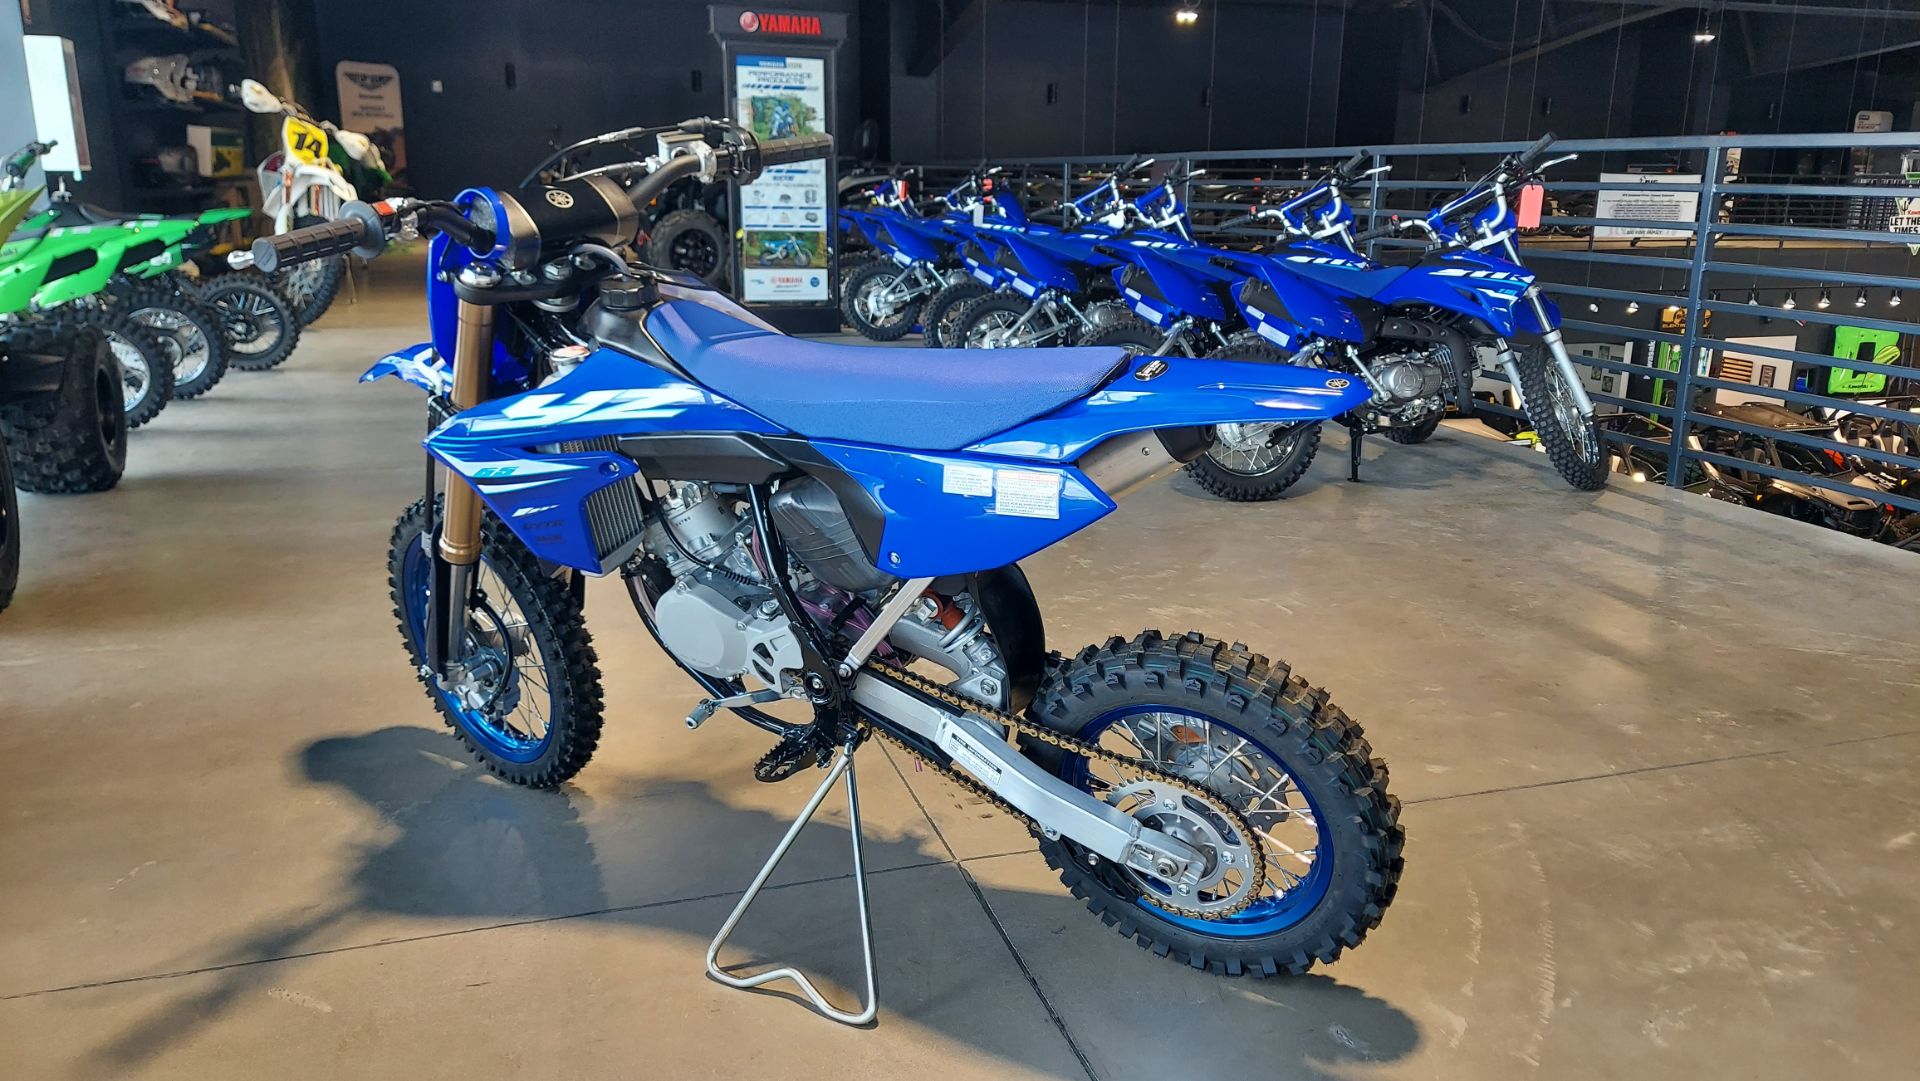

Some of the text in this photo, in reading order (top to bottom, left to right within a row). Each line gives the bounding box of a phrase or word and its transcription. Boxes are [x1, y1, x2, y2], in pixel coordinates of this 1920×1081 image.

[758, 13, 822, 34] YAMAHA
[1890, 217, 1904, 226] LET
[472, 388, 695, 432] YZ
[473, 466, 519, 478] 65
